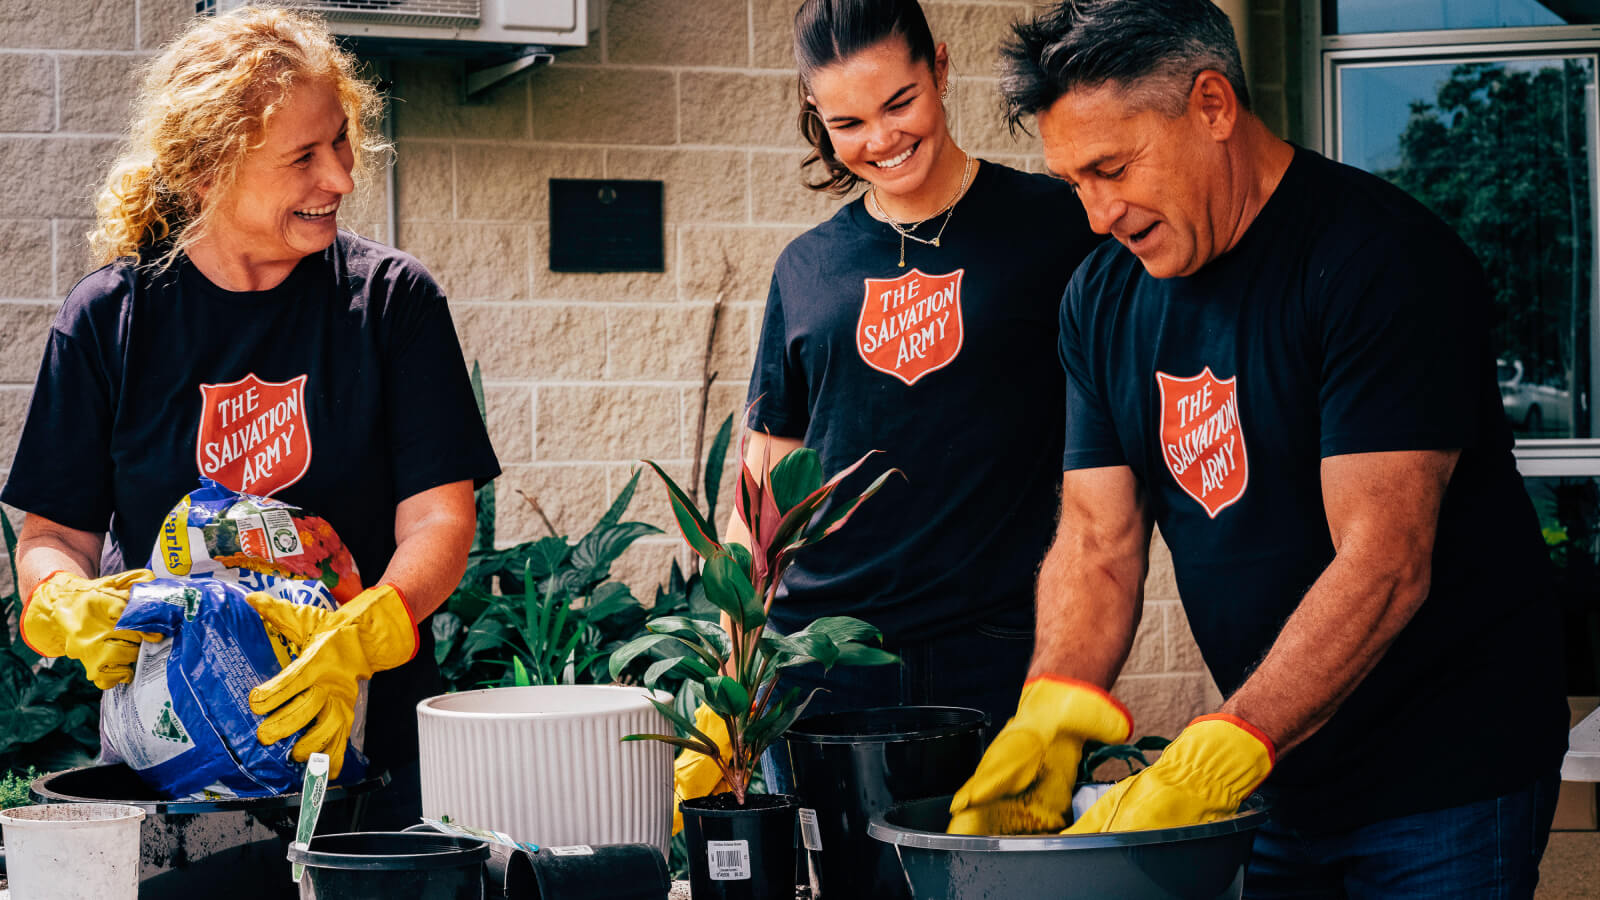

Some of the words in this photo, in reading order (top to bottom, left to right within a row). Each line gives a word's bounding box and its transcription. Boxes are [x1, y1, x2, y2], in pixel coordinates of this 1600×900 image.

[863, 281, 955, 353] SALVATION
[880, 278, 920, 313] THE
[895, 310, 950, 370] ARMY
[204, 388, 298, 473] SALVATION
[218, 385, 260, 429] THE
[1167, 391, 1237, 475] SALVATION
[1177, 381, 1213, 428] THE
[241, 423, 295, 492] ARMY
[1200, 434, 1235, 498] ARMY
[164, 510, 184, 569] earles
